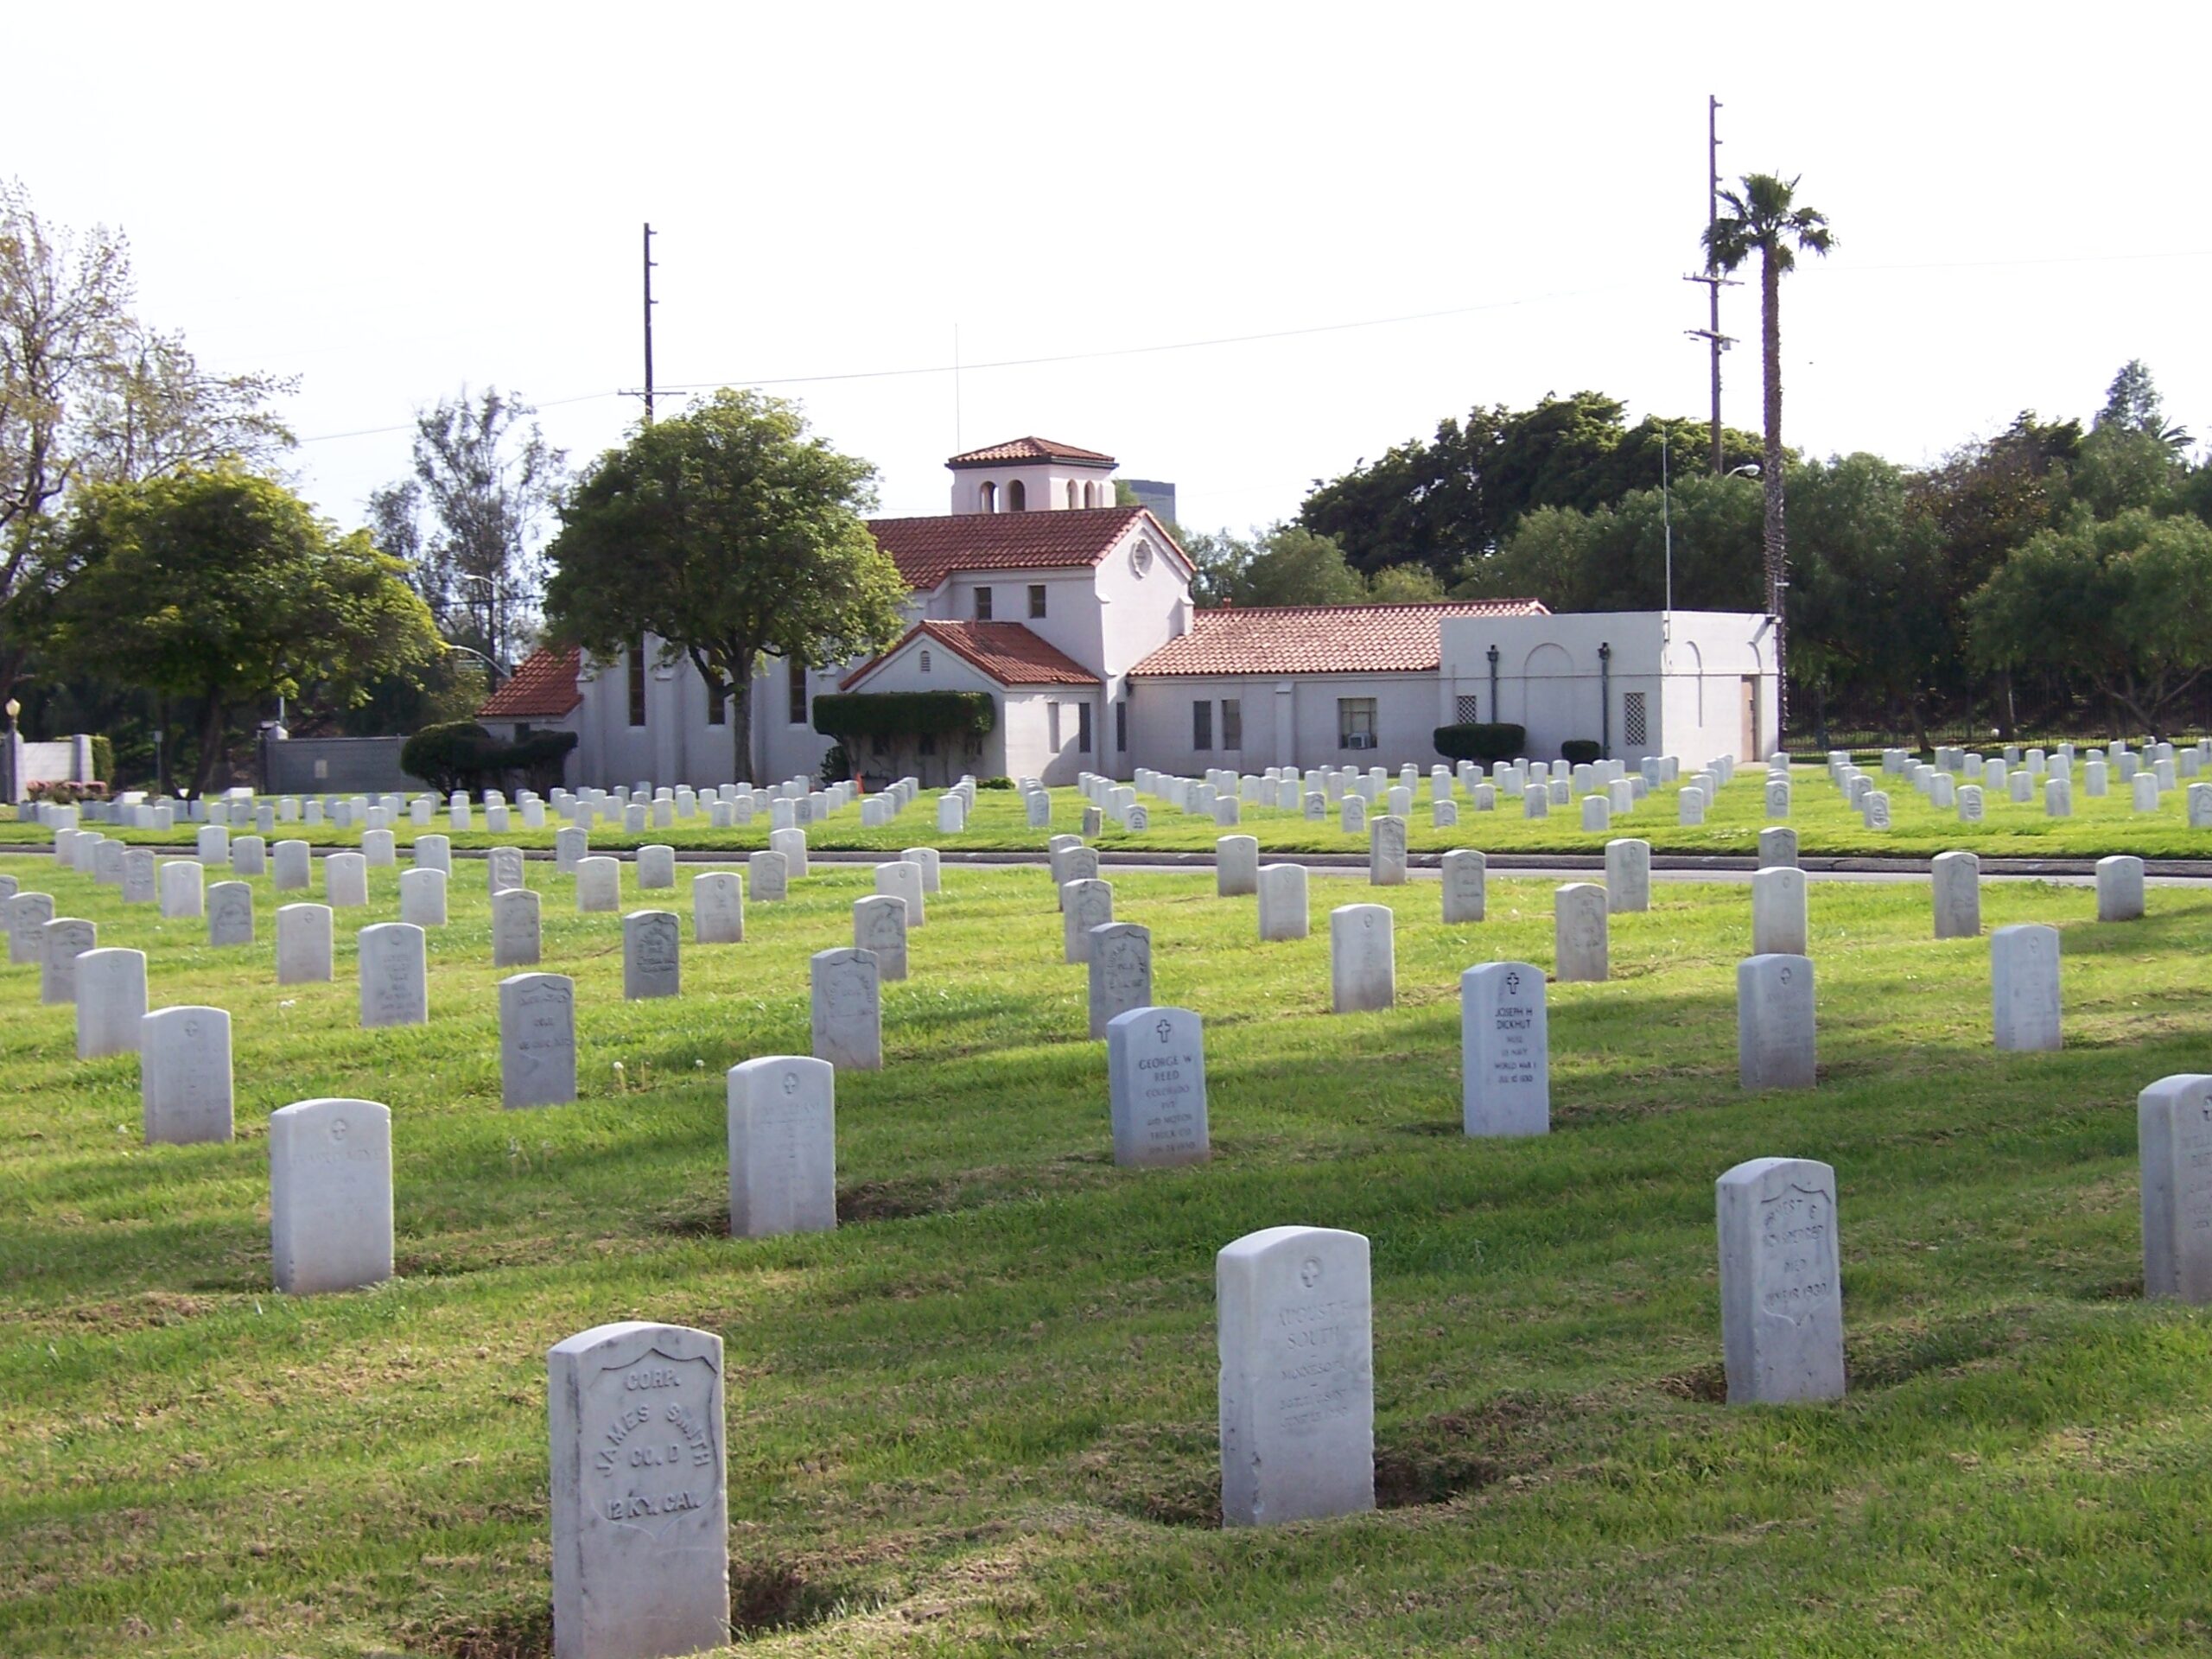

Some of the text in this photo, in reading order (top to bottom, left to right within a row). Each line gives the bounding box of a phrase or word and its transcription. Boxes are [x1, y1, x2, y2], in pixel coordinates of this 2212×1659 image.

[1495, 1007, 1523, 1017] JOSEPH
[1139, 1056, 1179, 1070] GEORGE
[1154, 1071, 1179, 1082] REED
[1146, 1084, 1190, 1097] COLORADO
[626, 1368, 681, 1391] CORP.
[594, 1402, 711, 1478] JAMES SMITH
[630, 1446, 663, 1468] CO.
